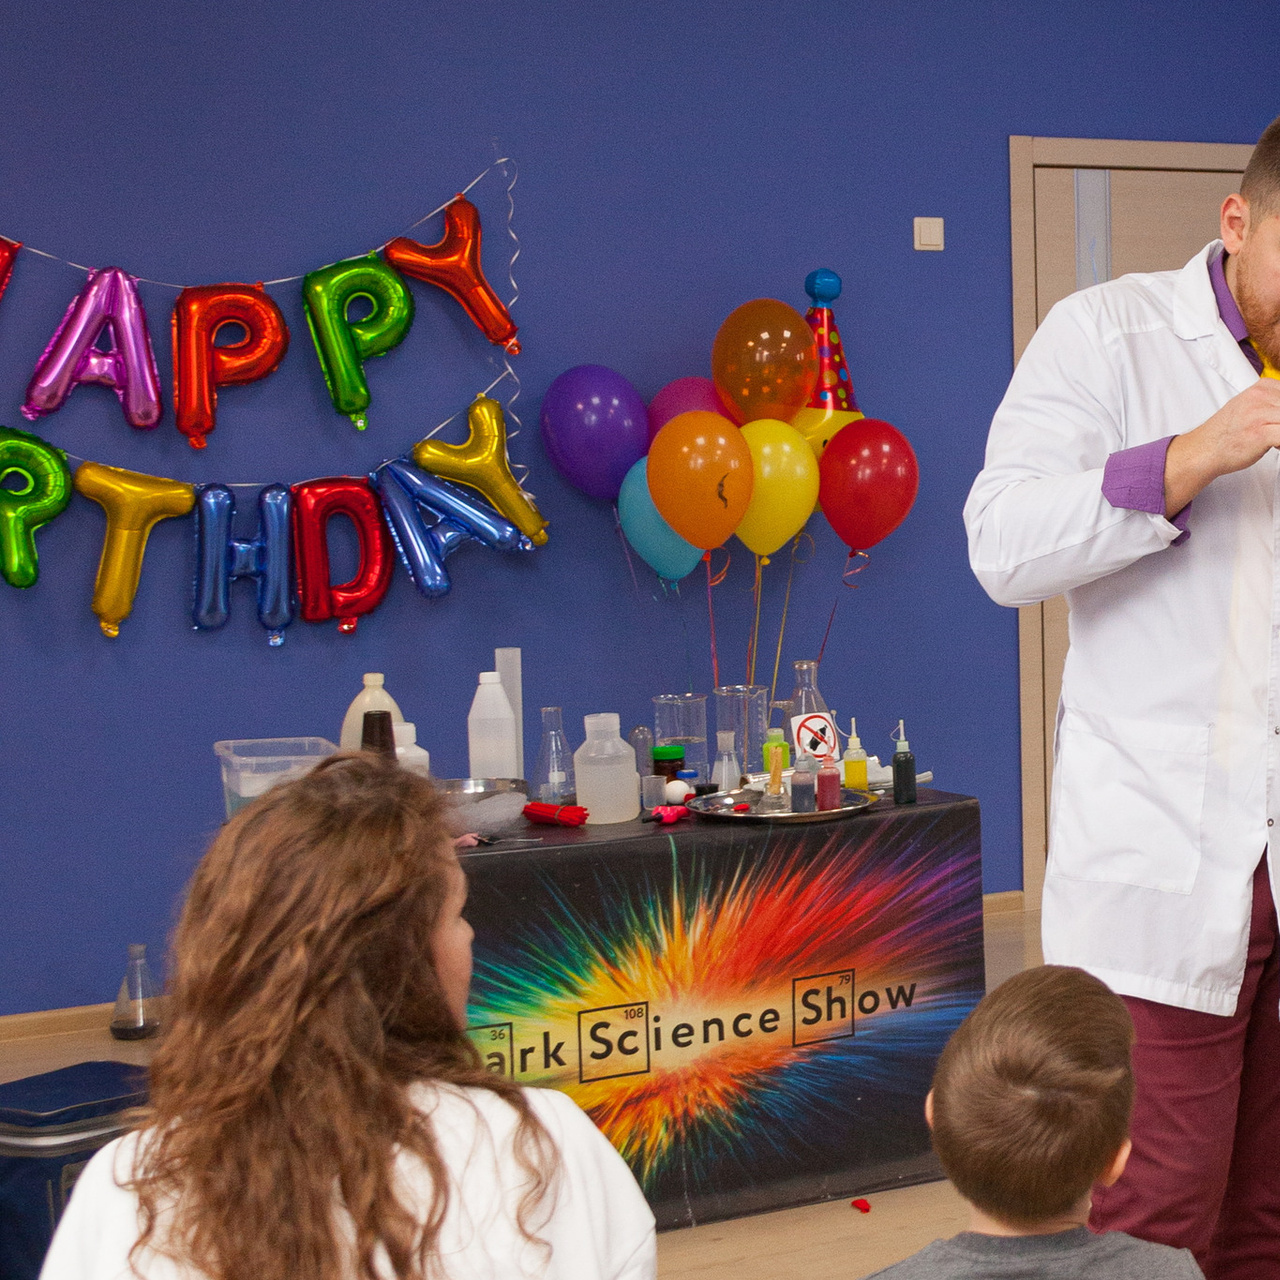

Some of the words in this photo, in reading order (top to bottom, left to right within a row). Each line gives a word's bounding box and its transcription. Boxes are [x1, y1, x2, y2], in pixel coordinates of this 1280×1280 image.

[0, 192, 520, 449] APPY
[839, 975, 850, 985] 79
[624, 1008, 644, 1020] 108
[589, 1008, 780, 1060] Science
[801, 983, 917, 1026] Show
[490, 1029, 505, 1041] 36
